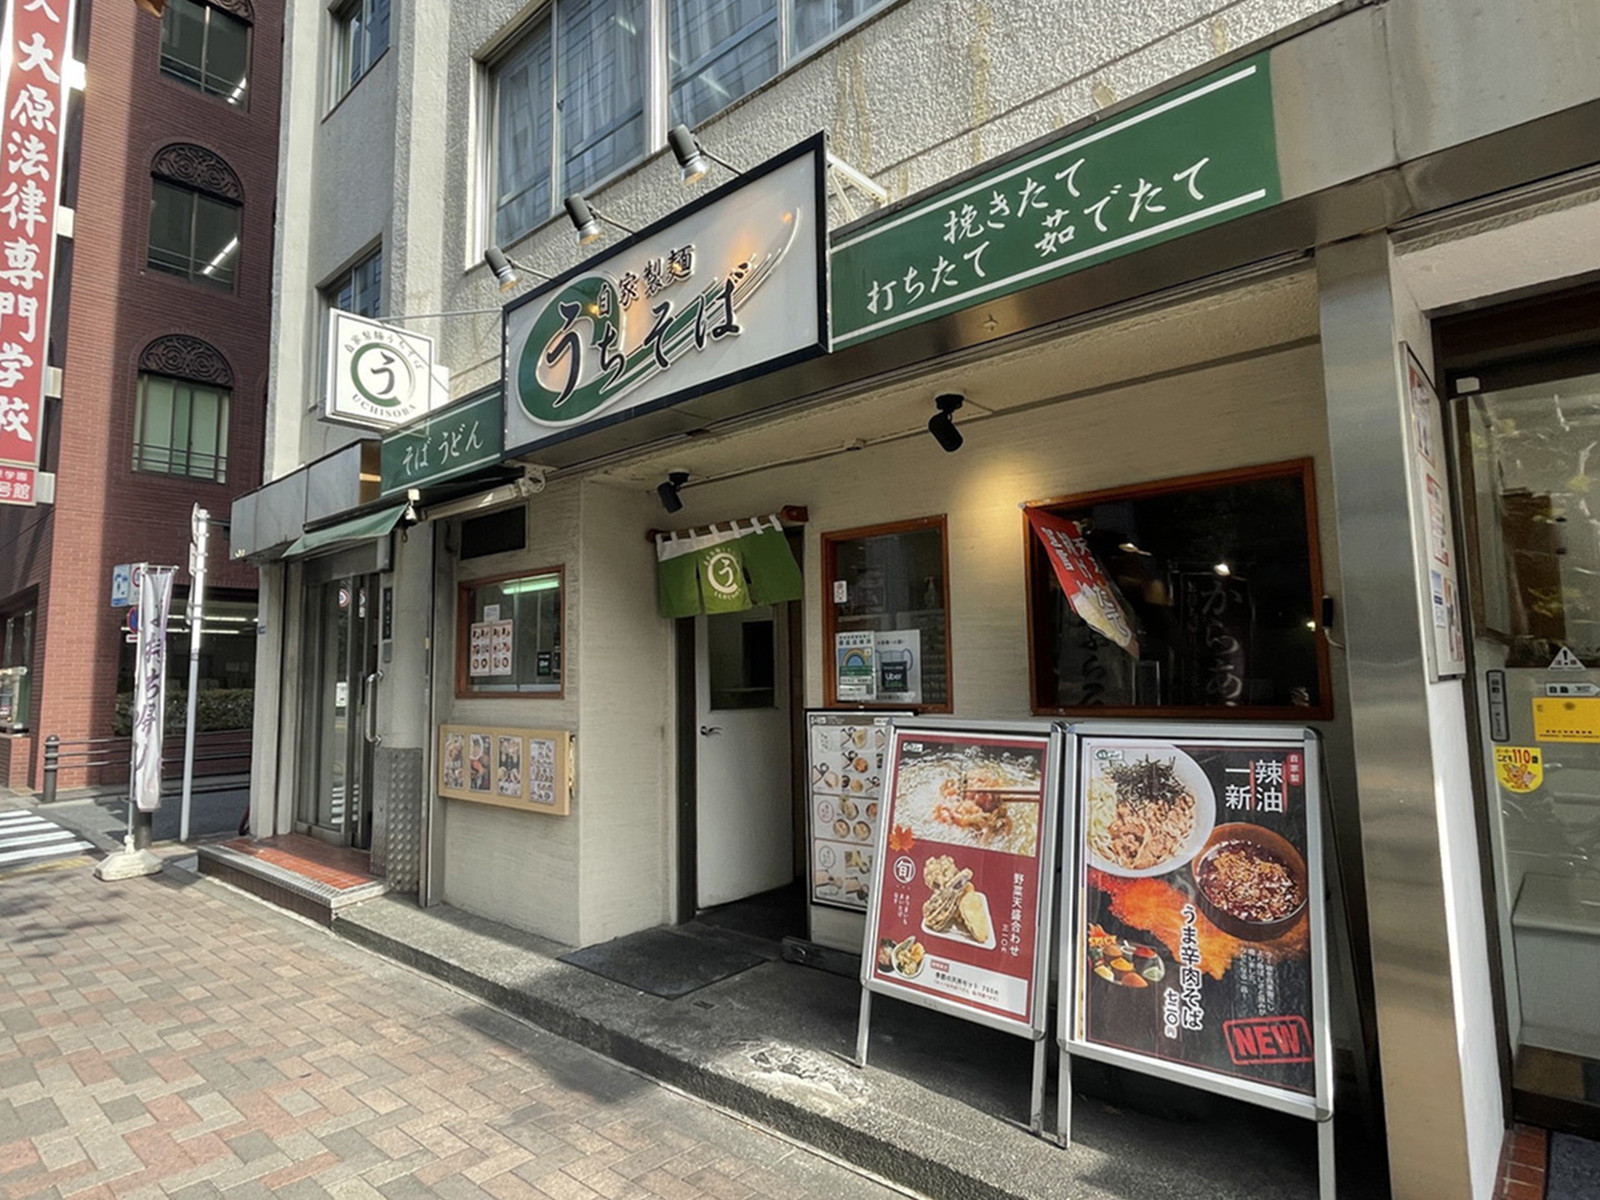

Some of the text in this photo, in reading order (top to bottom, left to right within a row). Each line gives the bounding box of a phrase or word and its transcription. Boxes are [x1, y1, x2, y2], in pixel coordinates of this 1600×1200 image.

[943, 158, 1085, 244] 挽きたて
[867, 157, 1210, 314] 打ちたて 茹でたて
[597, 245, 695, 316] 自家製麺
[546, 261, 750, 407] うちそば
[370, 351, 395, 395] う
[402, 421, 484, 476] そば うどん
[719, 559, 734, 587] う
[1201, 579, 1244, 706] からあ
[1255, 760, 1283, 812] 辣油
[896, 859, 913, 882] 旬
[1180, 905, 1203, 1029] うま辛肉そば
[1234, 1024, 1300, 1056] NEW
